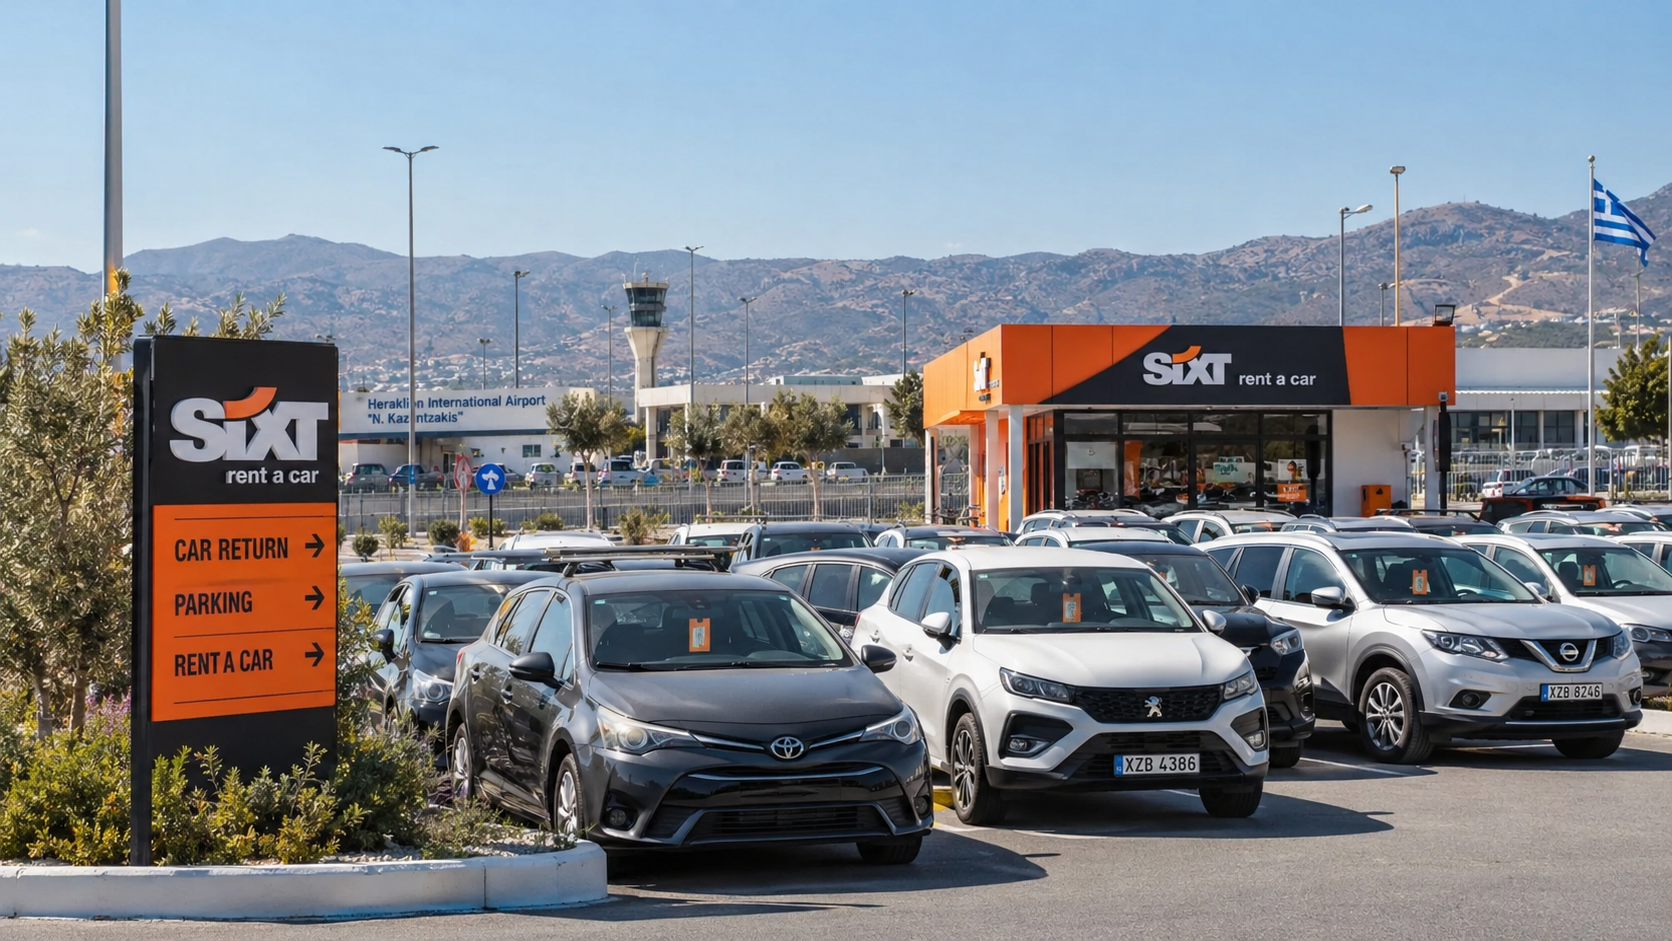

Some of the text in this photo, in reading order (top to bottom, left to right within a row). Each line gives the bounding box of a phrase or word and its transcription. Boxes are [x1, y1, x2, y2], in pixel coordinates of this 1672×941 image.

[1238, 372, 1272, 386] rent
[1276, 374, 1286, 386] a
[1290, 374, 1317, 386] car
[368, 394, 546, 410] Heraklin International Airport
[388, 411, 464, 424] Kazntzakis"
[226, 467, 319, 484] rent a car
[174, 537, 289, 562] CAR RETURN
[174, 590, 253, 616] PARKING
[174, 648, 274, 677] RENT A CAR
[1549, 684, 1601, 699] XZB 8246
[1125, 756, 1154, 773] XZB
[1159, 755, 1197, 772] 4386
